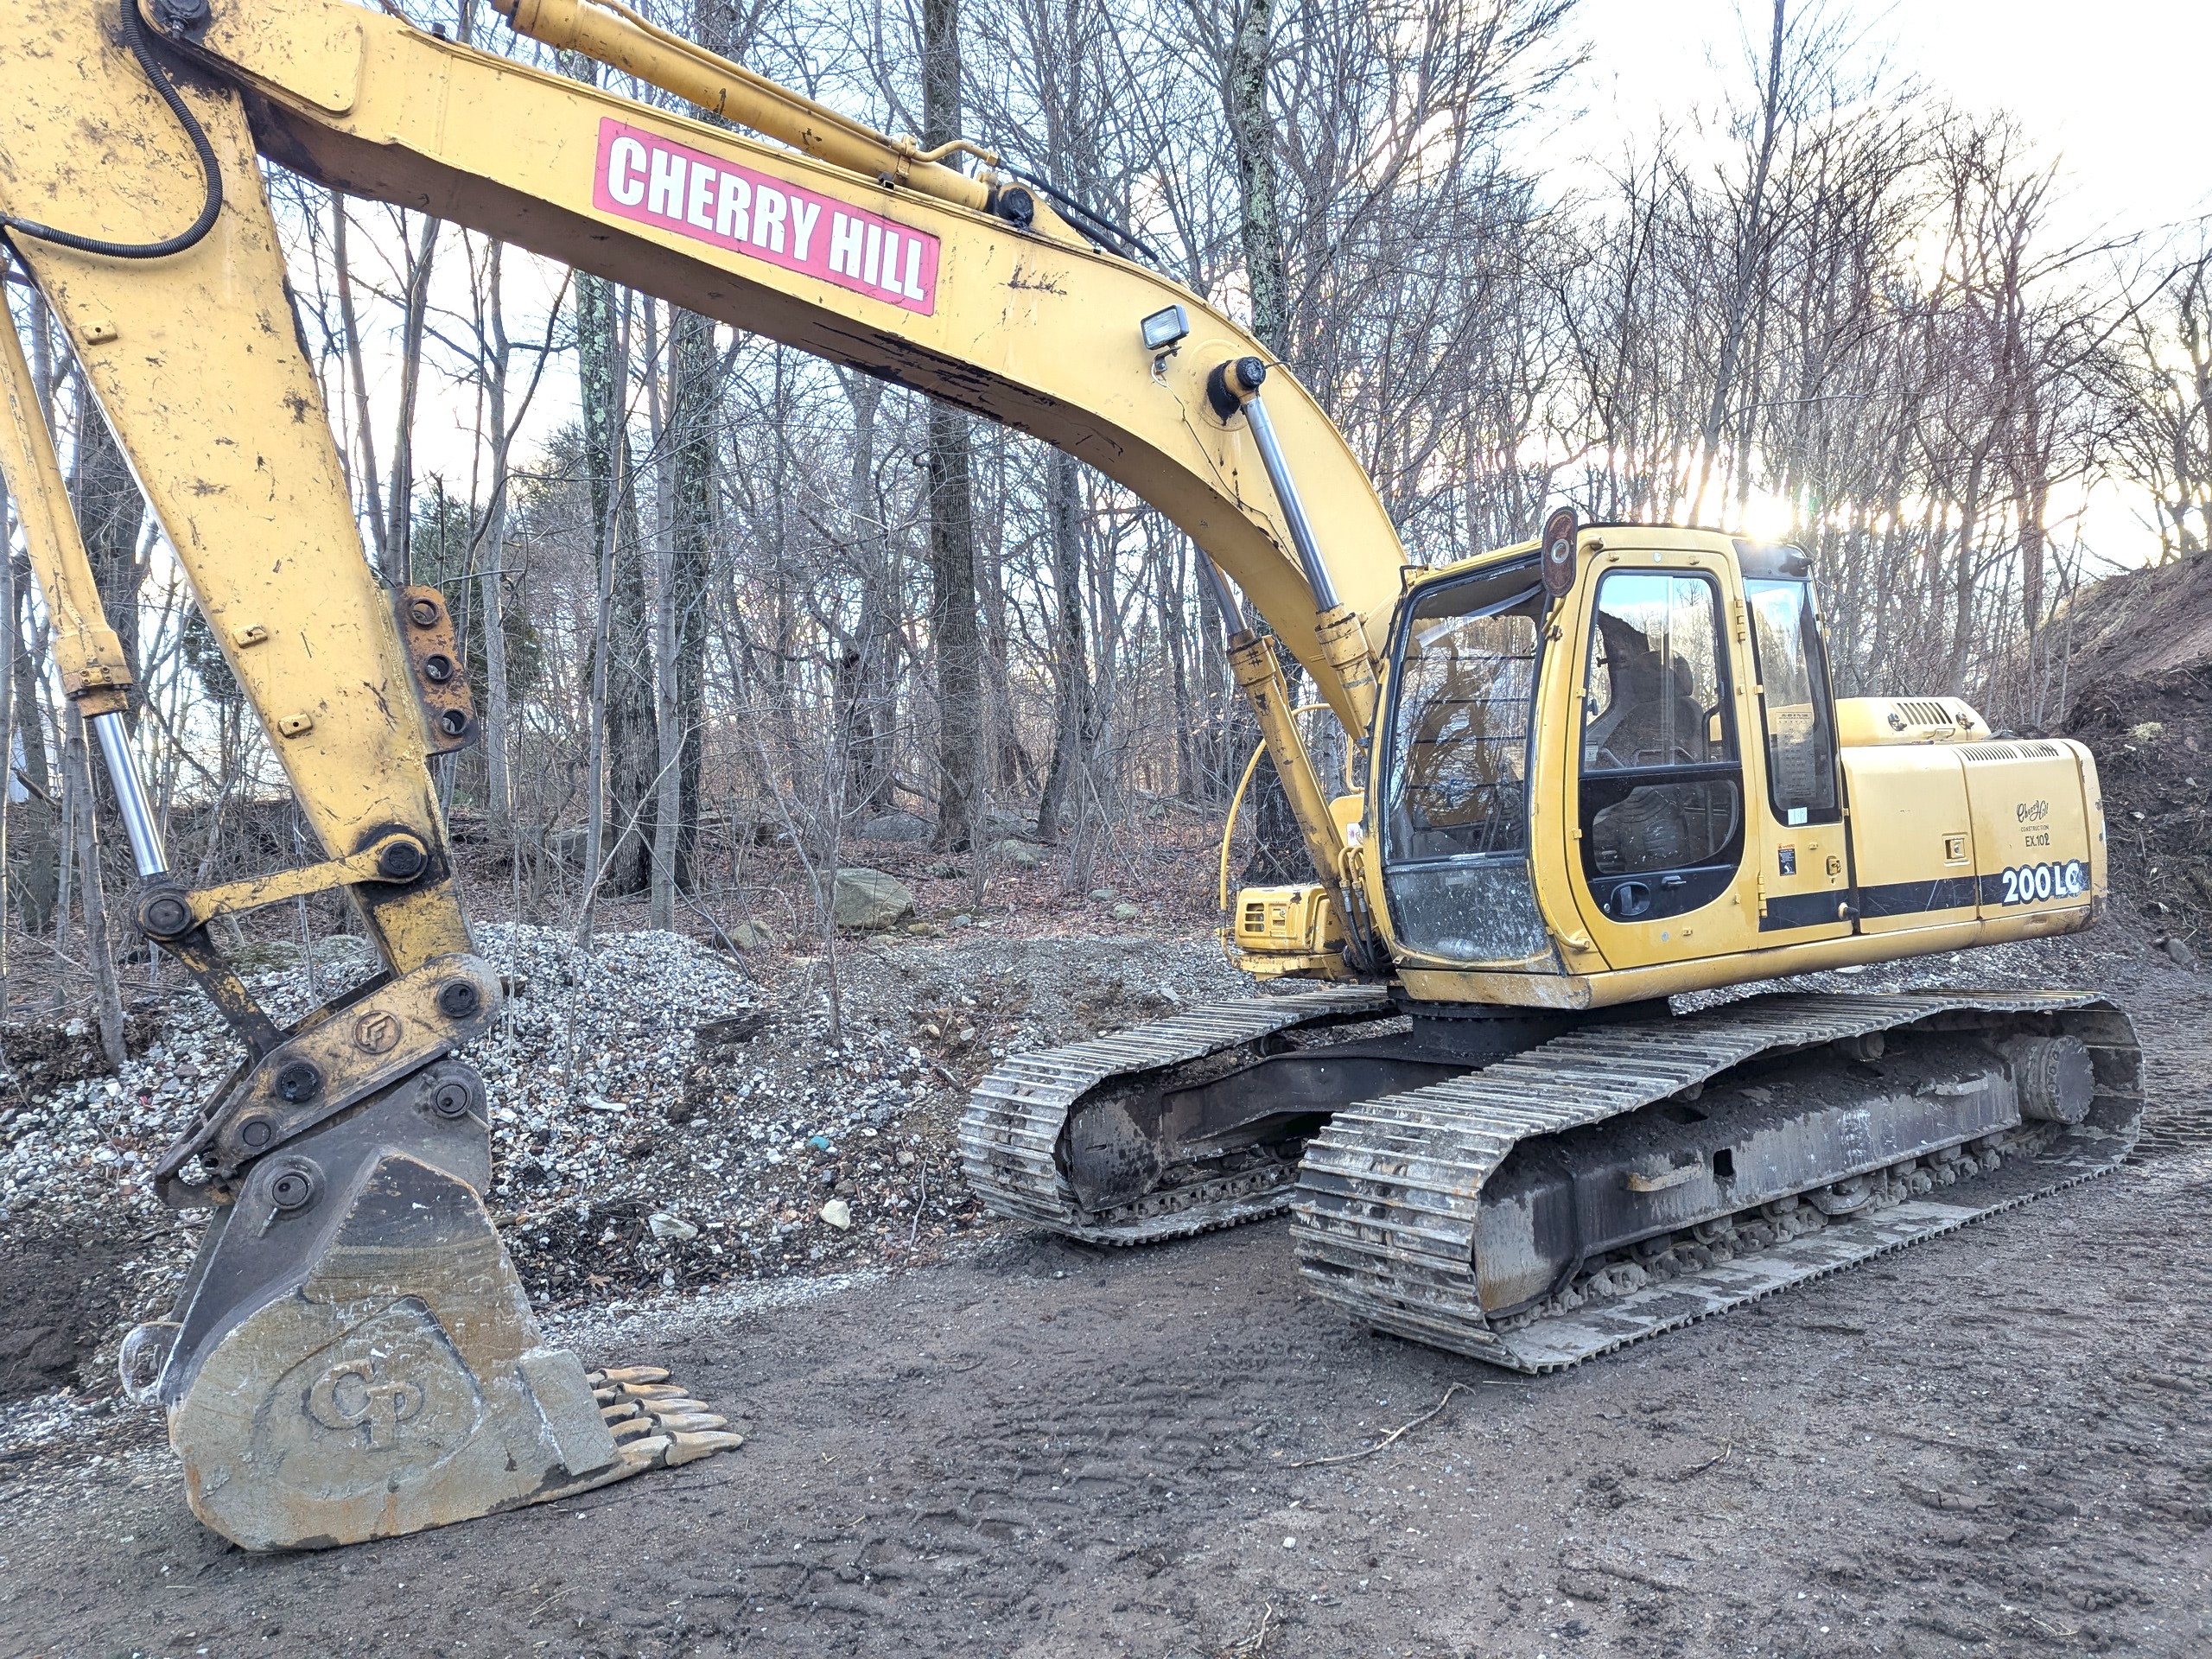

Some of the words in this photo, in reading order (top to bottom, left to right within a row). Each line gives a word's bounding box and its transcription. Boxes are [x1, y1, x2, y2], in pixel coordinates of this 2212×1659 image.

[607, 136, 821, 261] CHERRY
[829, 211, 925, 302] HILL
[2020, 823, 2050, 833] CONSTRUCTION
[2024, 832, 2050, 848] EX.102
